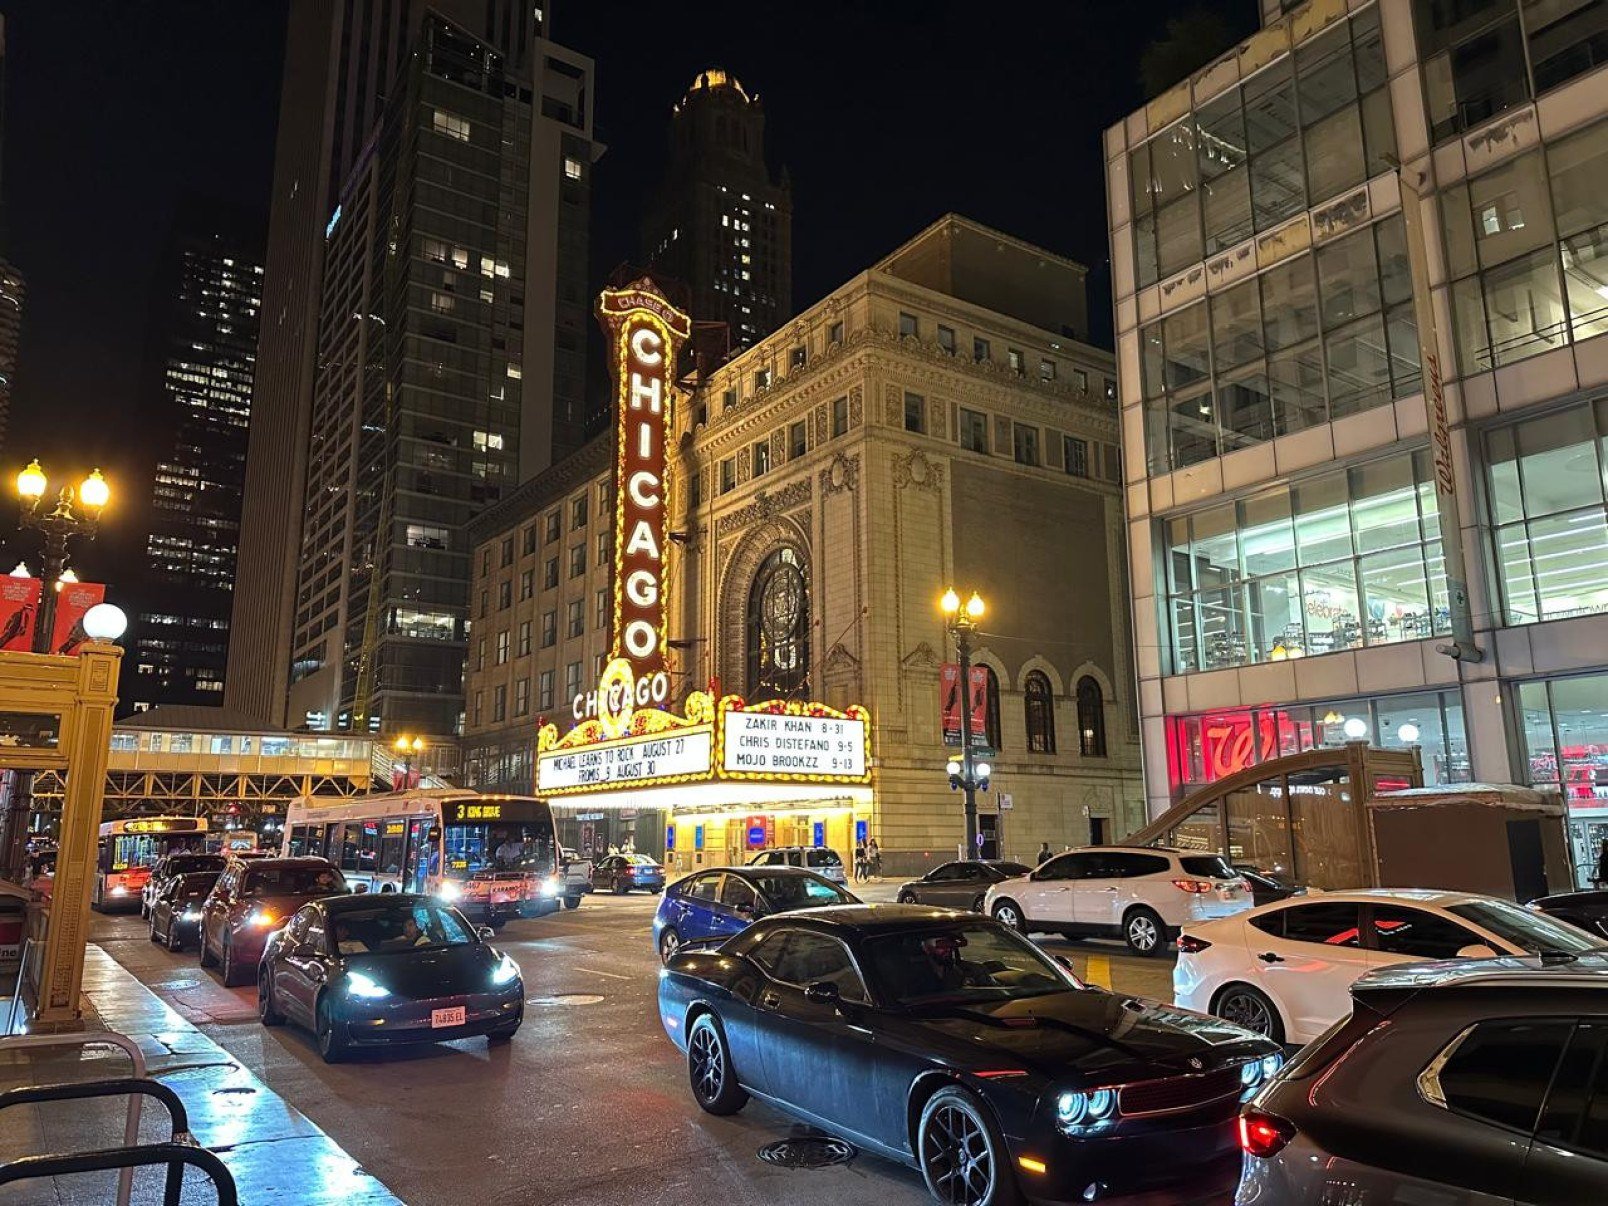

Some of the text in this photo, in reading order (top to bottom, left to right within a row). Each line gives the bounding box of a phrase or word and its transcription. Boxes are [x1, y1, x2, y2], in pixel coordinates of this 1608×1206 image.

[1427, 354, 1453, 496] Walgreens
[624, 328, 662, 658] CHICAGO
[572, 671, 668, 720] CHCAGO
[745, 717, 844, 734] ZAKIR KHAN 8-31
[739, 735, 853, 752] CHRIS DISTEFANO 9-5
[553, 739, 685, 771] MICHAEL LEARNS TO ROCK AUGUST 27
[736, 753, 853, 769] MOJO BROOKZZ 9-13
[617, 762, 642, 778] AUGUST
[646, 761, 656, 776] 30
[457, 804, 465, 819] 3
